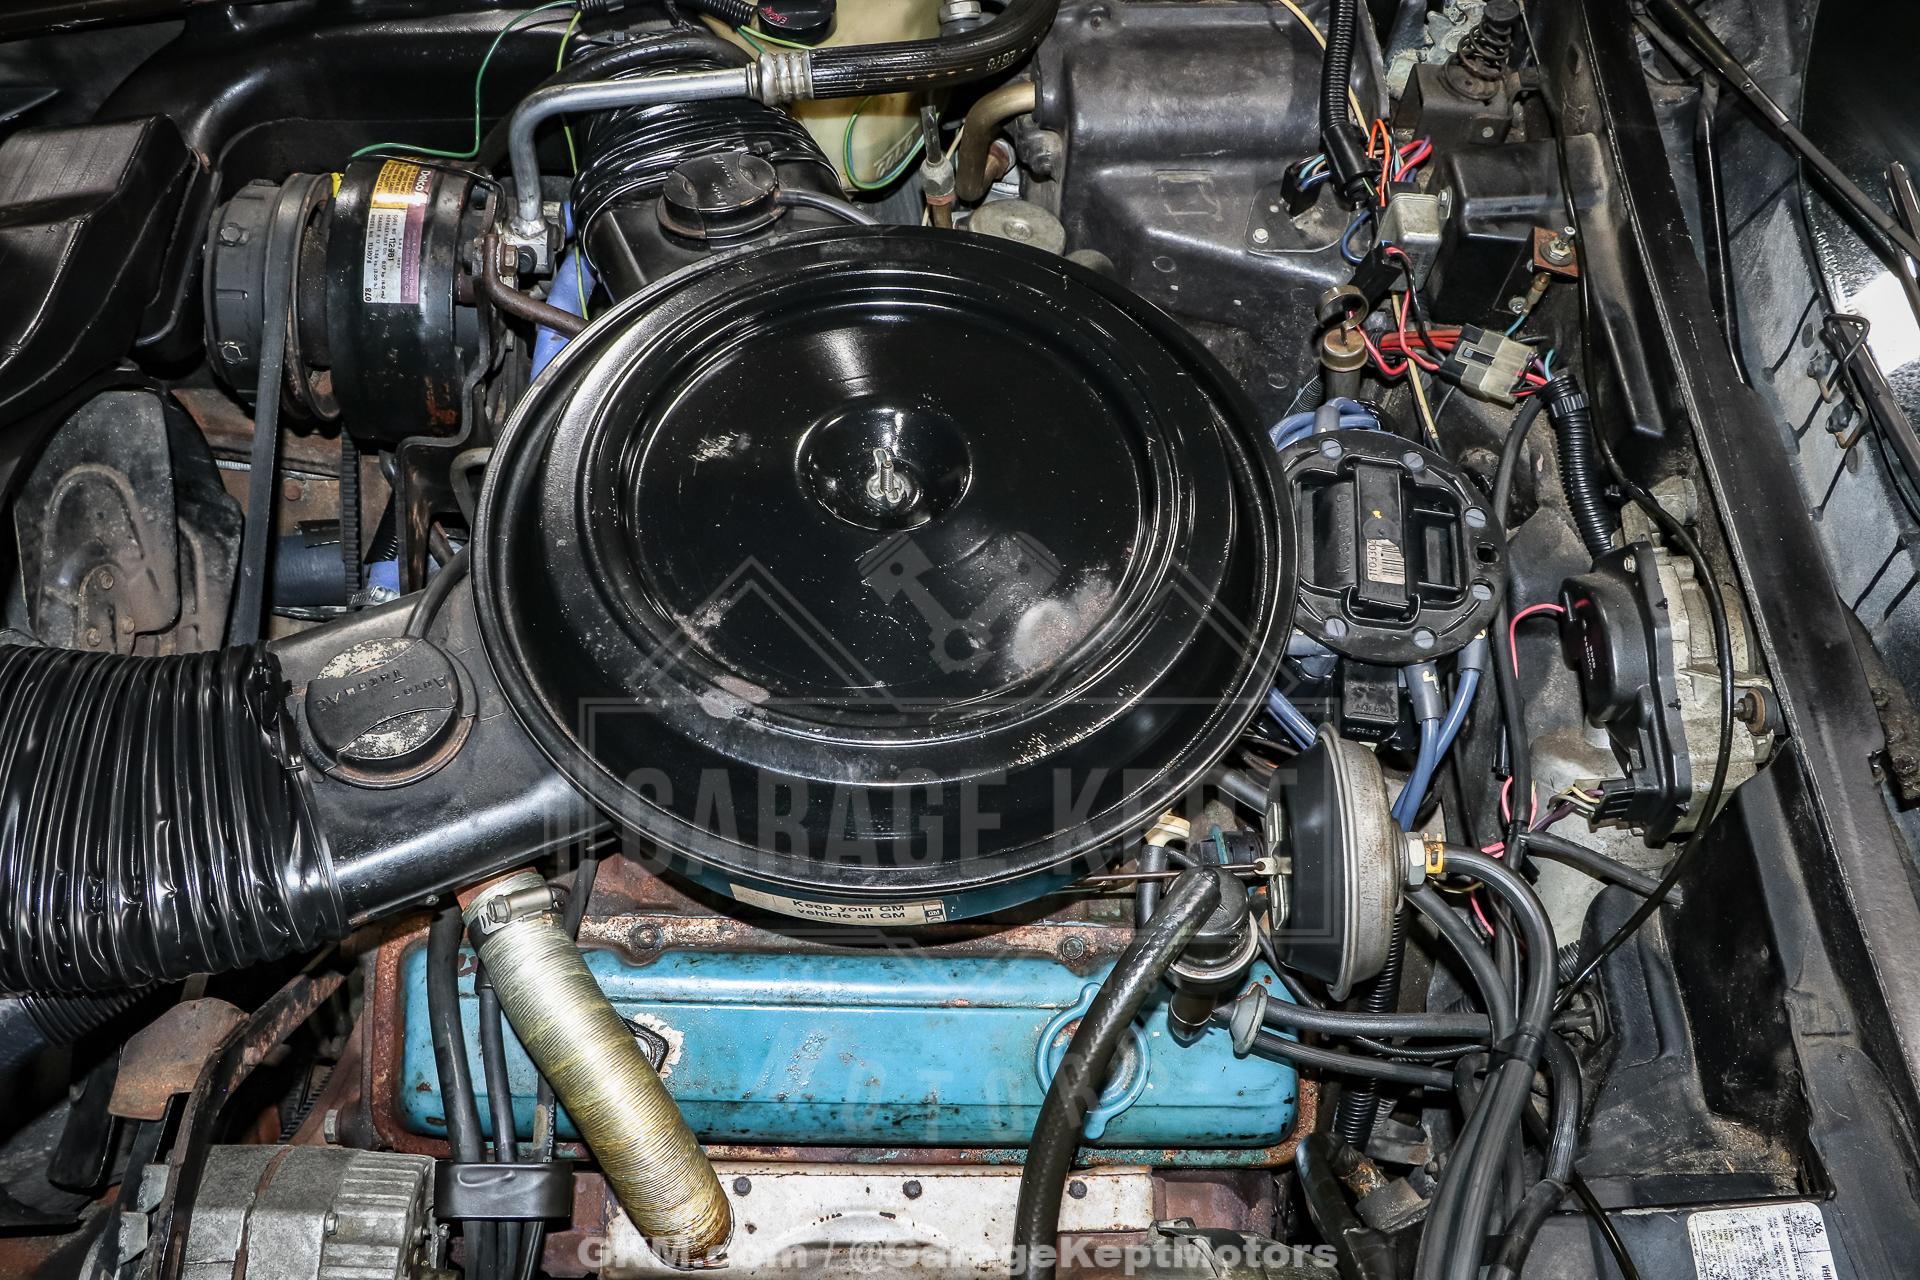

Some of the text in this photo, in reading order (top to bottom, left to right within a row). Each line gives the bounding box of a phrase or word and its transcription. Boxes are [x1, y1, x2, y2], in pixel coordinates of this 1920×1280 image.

[416, 169, 431, 192] Delco
[792, 899, 905, 913] Keep your GM
[797, 909, 852, 919] vehicle
[857, 911, 875, 919] all
[1813, 1219, 1823, 1234] X6
